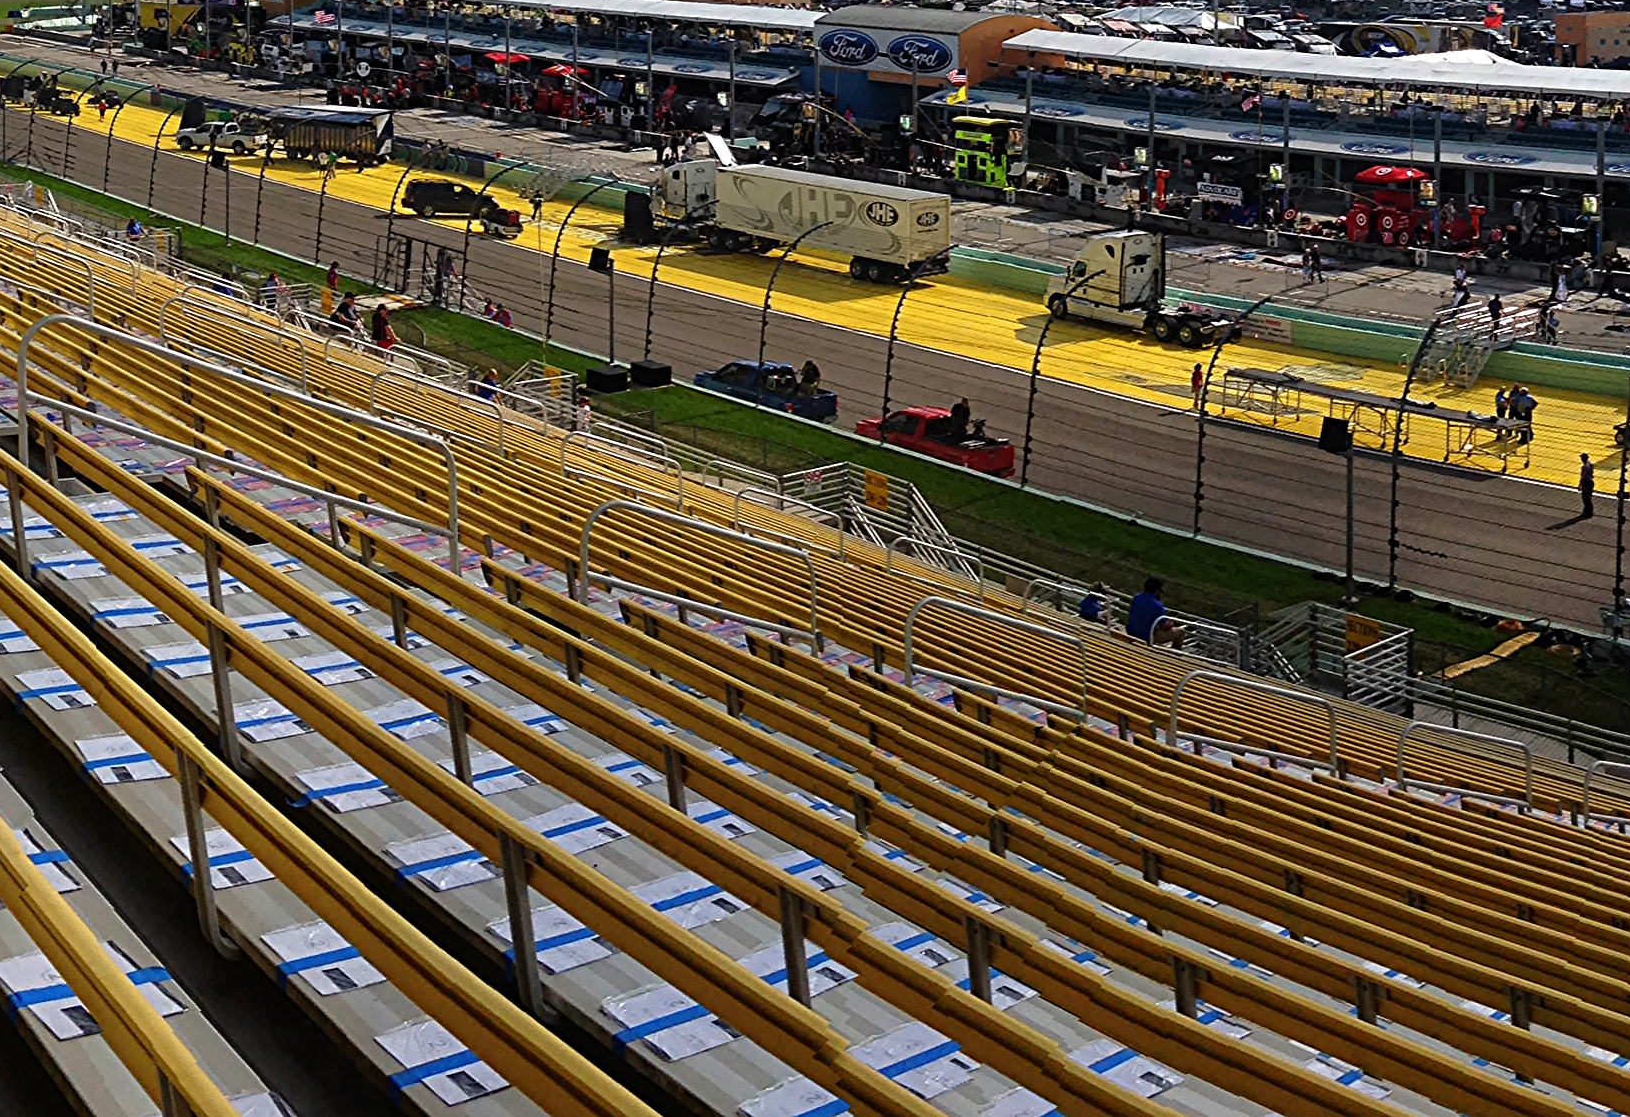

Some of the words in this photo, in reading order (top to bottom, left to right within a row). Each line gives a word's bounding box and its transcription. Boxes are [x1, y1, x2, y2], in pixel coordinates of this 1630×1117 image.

[829, 31, 868, 58] Ford
[898, 36, 939, 65] Ford
[870, 203, 897, 223] JHE
[919, 213, 937, 226] JHE
